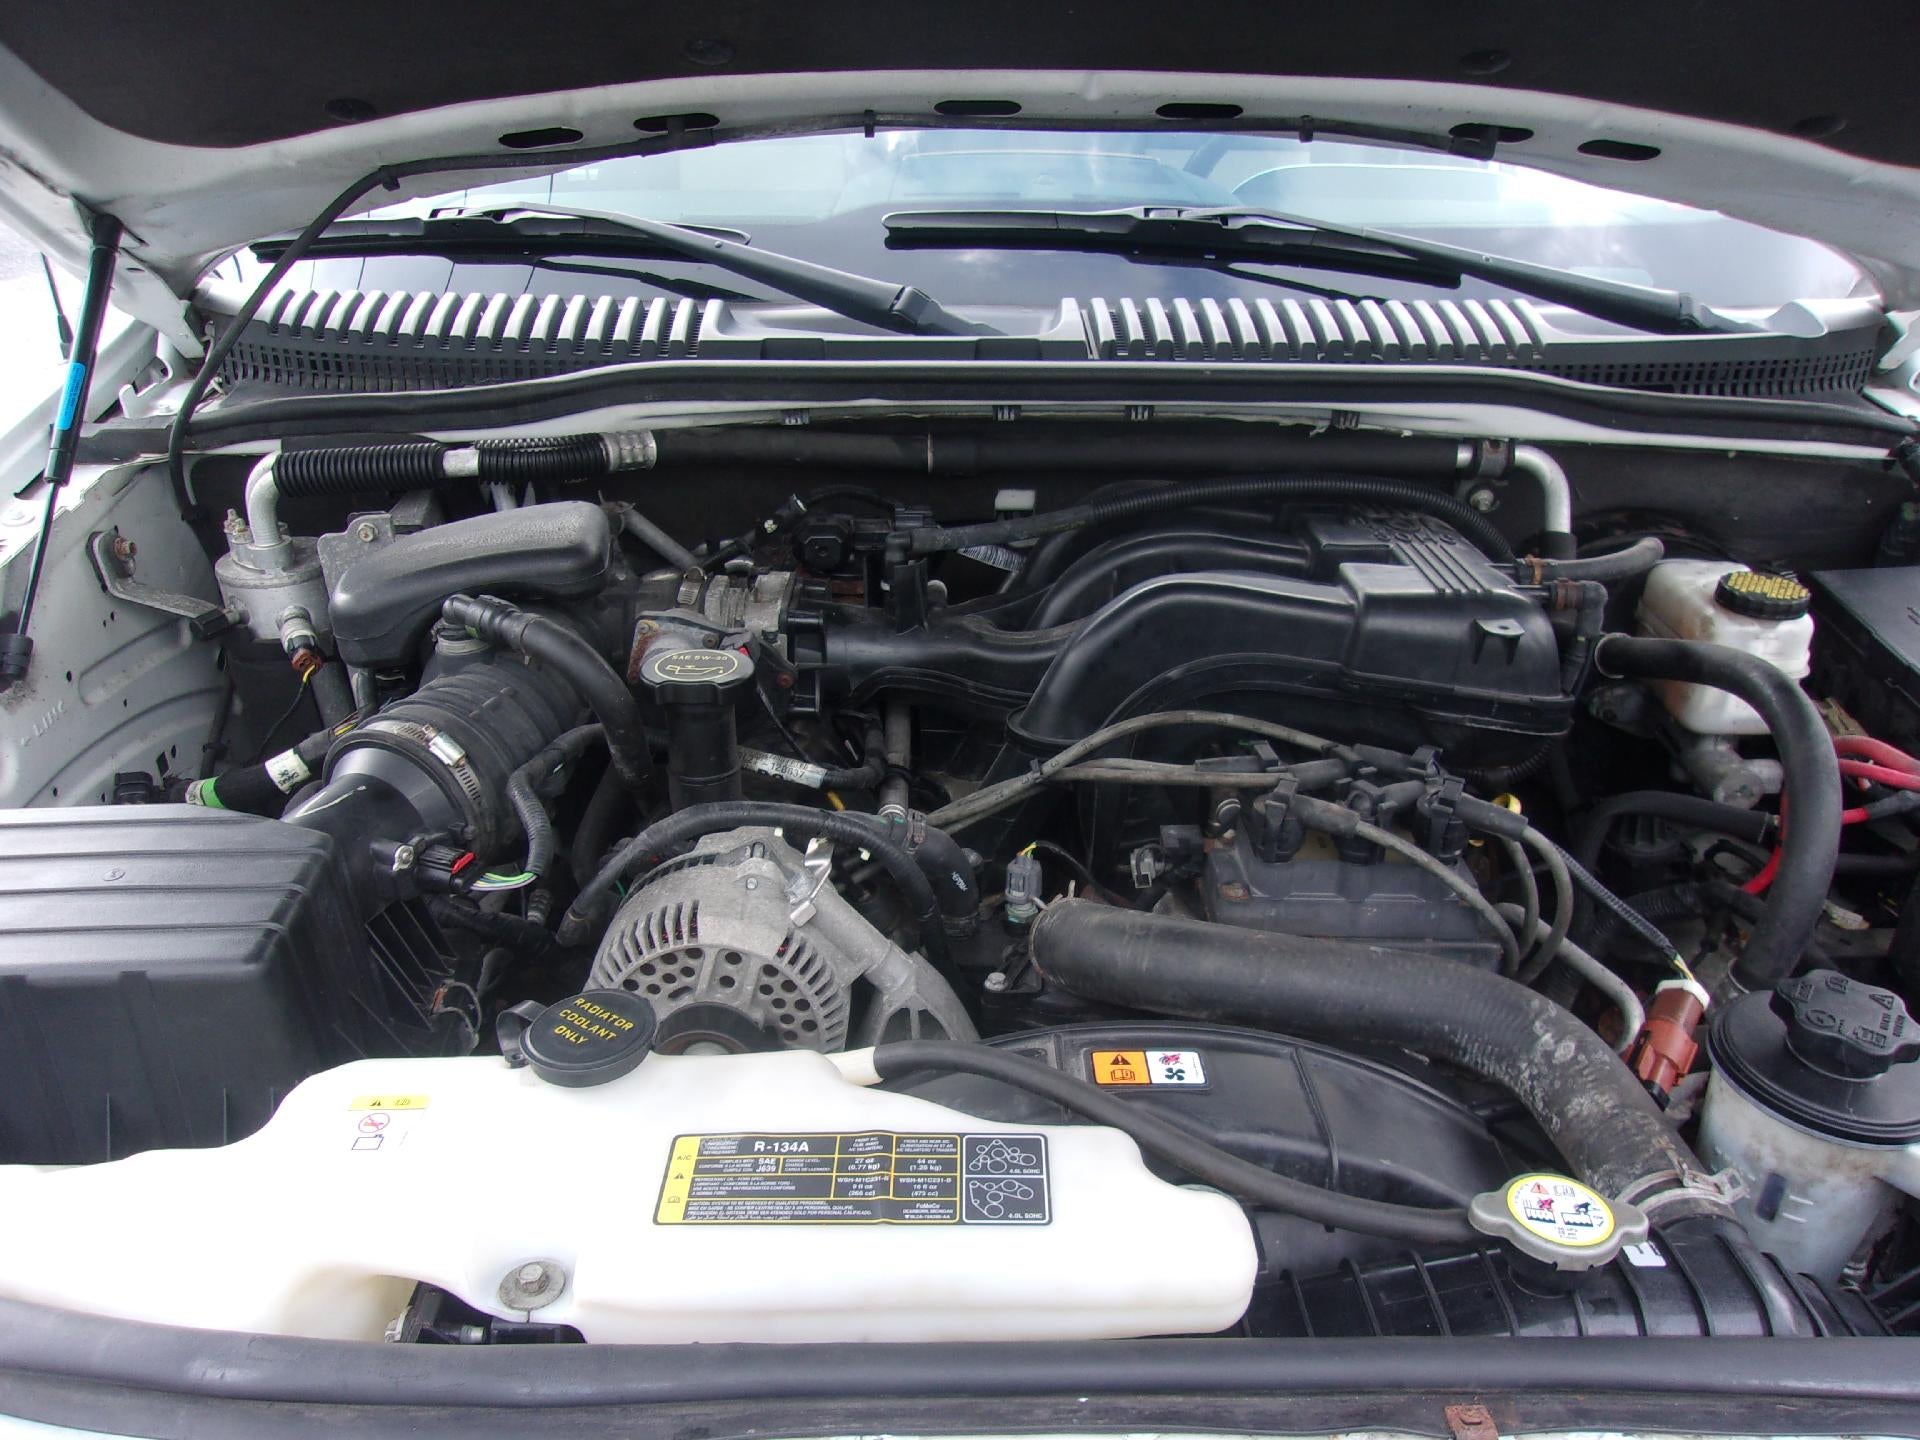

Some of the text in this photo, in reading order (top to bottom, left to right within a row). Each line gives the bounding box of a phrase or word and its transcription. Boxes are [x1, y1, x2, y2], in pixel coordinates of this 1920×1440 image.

[559, 1009, 617, 1041] COOLANT
[574, 997, 635, 1031] RADIATOR
[554, 1025, 588, 1044] ONLY
[753, 1141, 809, 1152] R-134A
